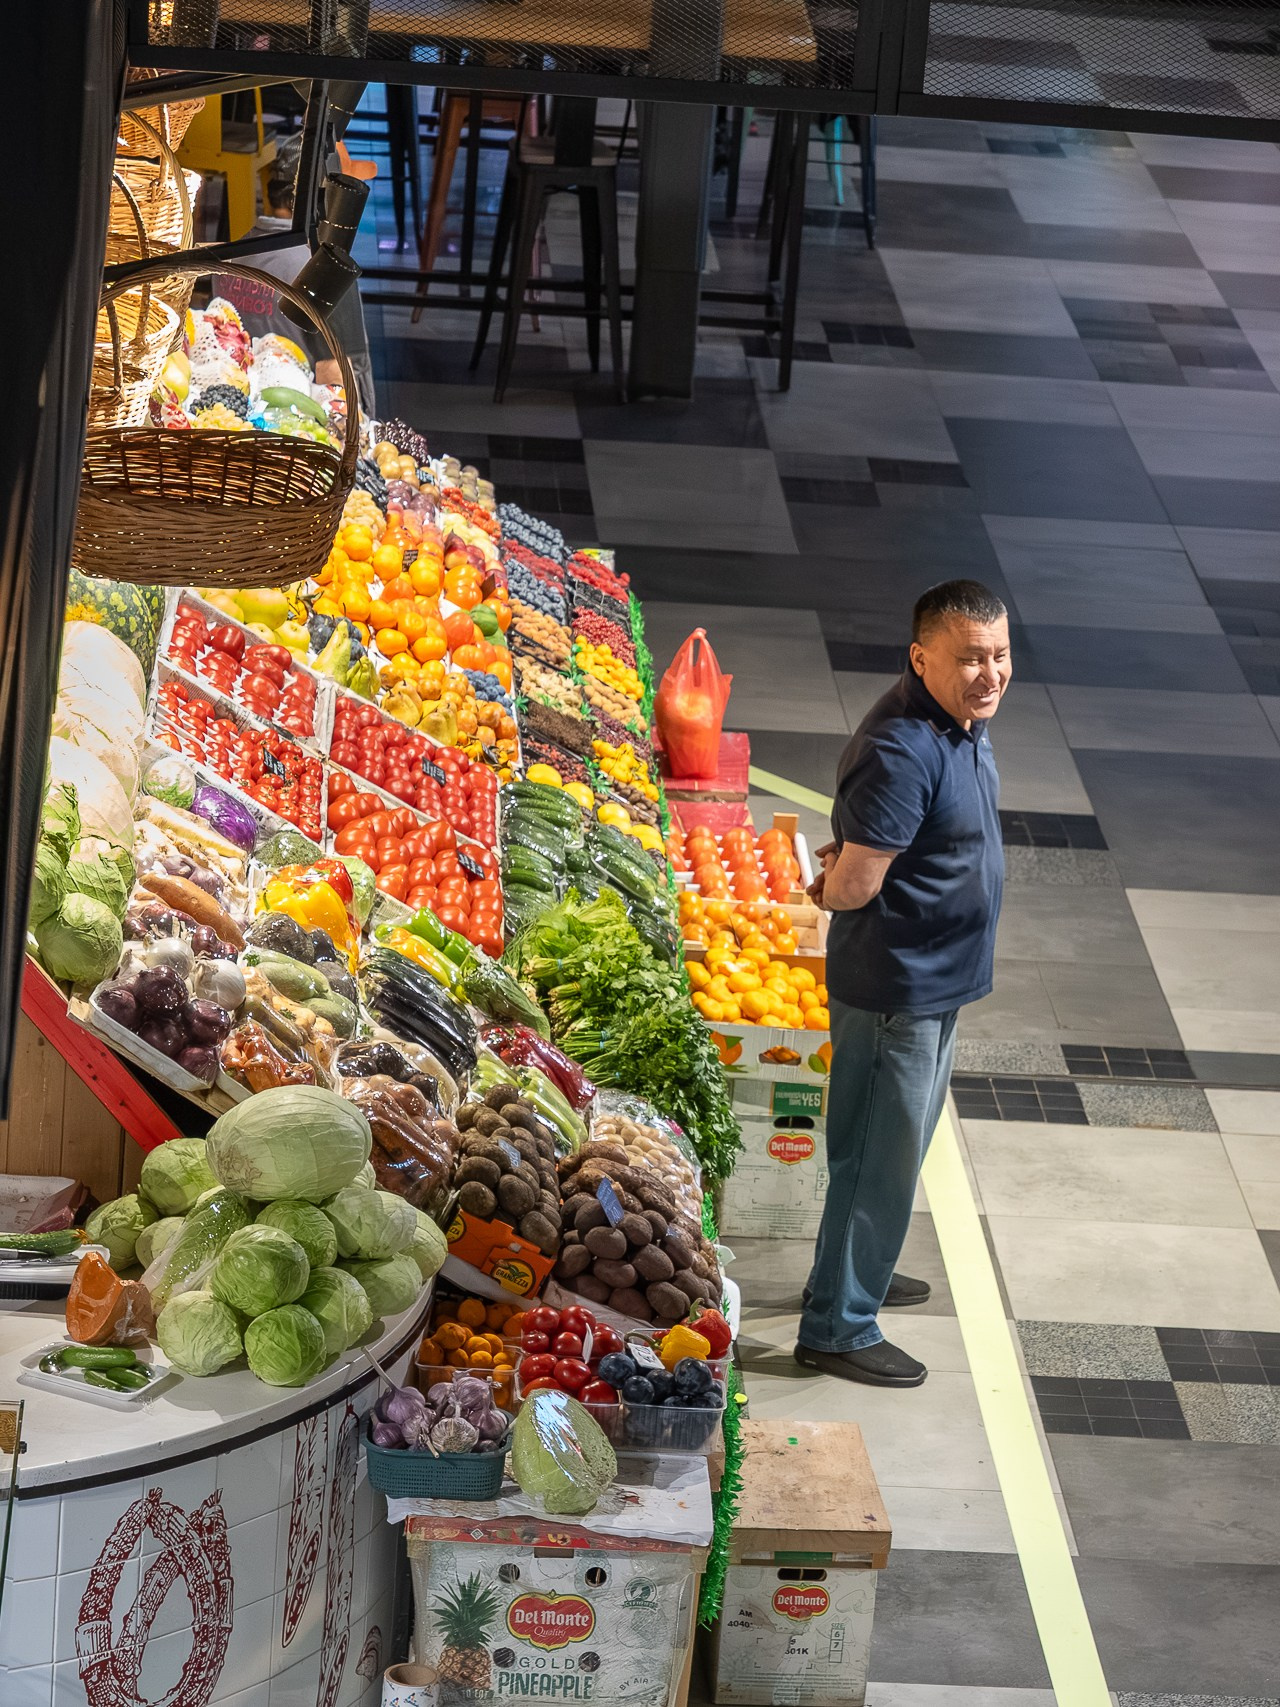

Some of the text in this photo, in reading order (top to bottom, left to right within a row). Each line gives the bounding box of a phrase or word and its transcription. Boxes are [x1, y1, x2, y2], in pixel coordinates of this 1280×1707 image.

[802, 1092, 821, 1107] YES
[771, 1141, 785, 1151] Del
[778, 1594, 827, 1607] Del Monte
[514, 1608, 590, 1628] Del Monte
[738, 1609, 753, 1618] AM
[727, 1620, 754, 1628] 4040
[533, 1626, 567, 1639] Quality
[834, 1630, 840, 1638] 6
[519, 1657, 575, 1670] GOLD
[498, 1671, 593, 1700] PINEAPPLE
